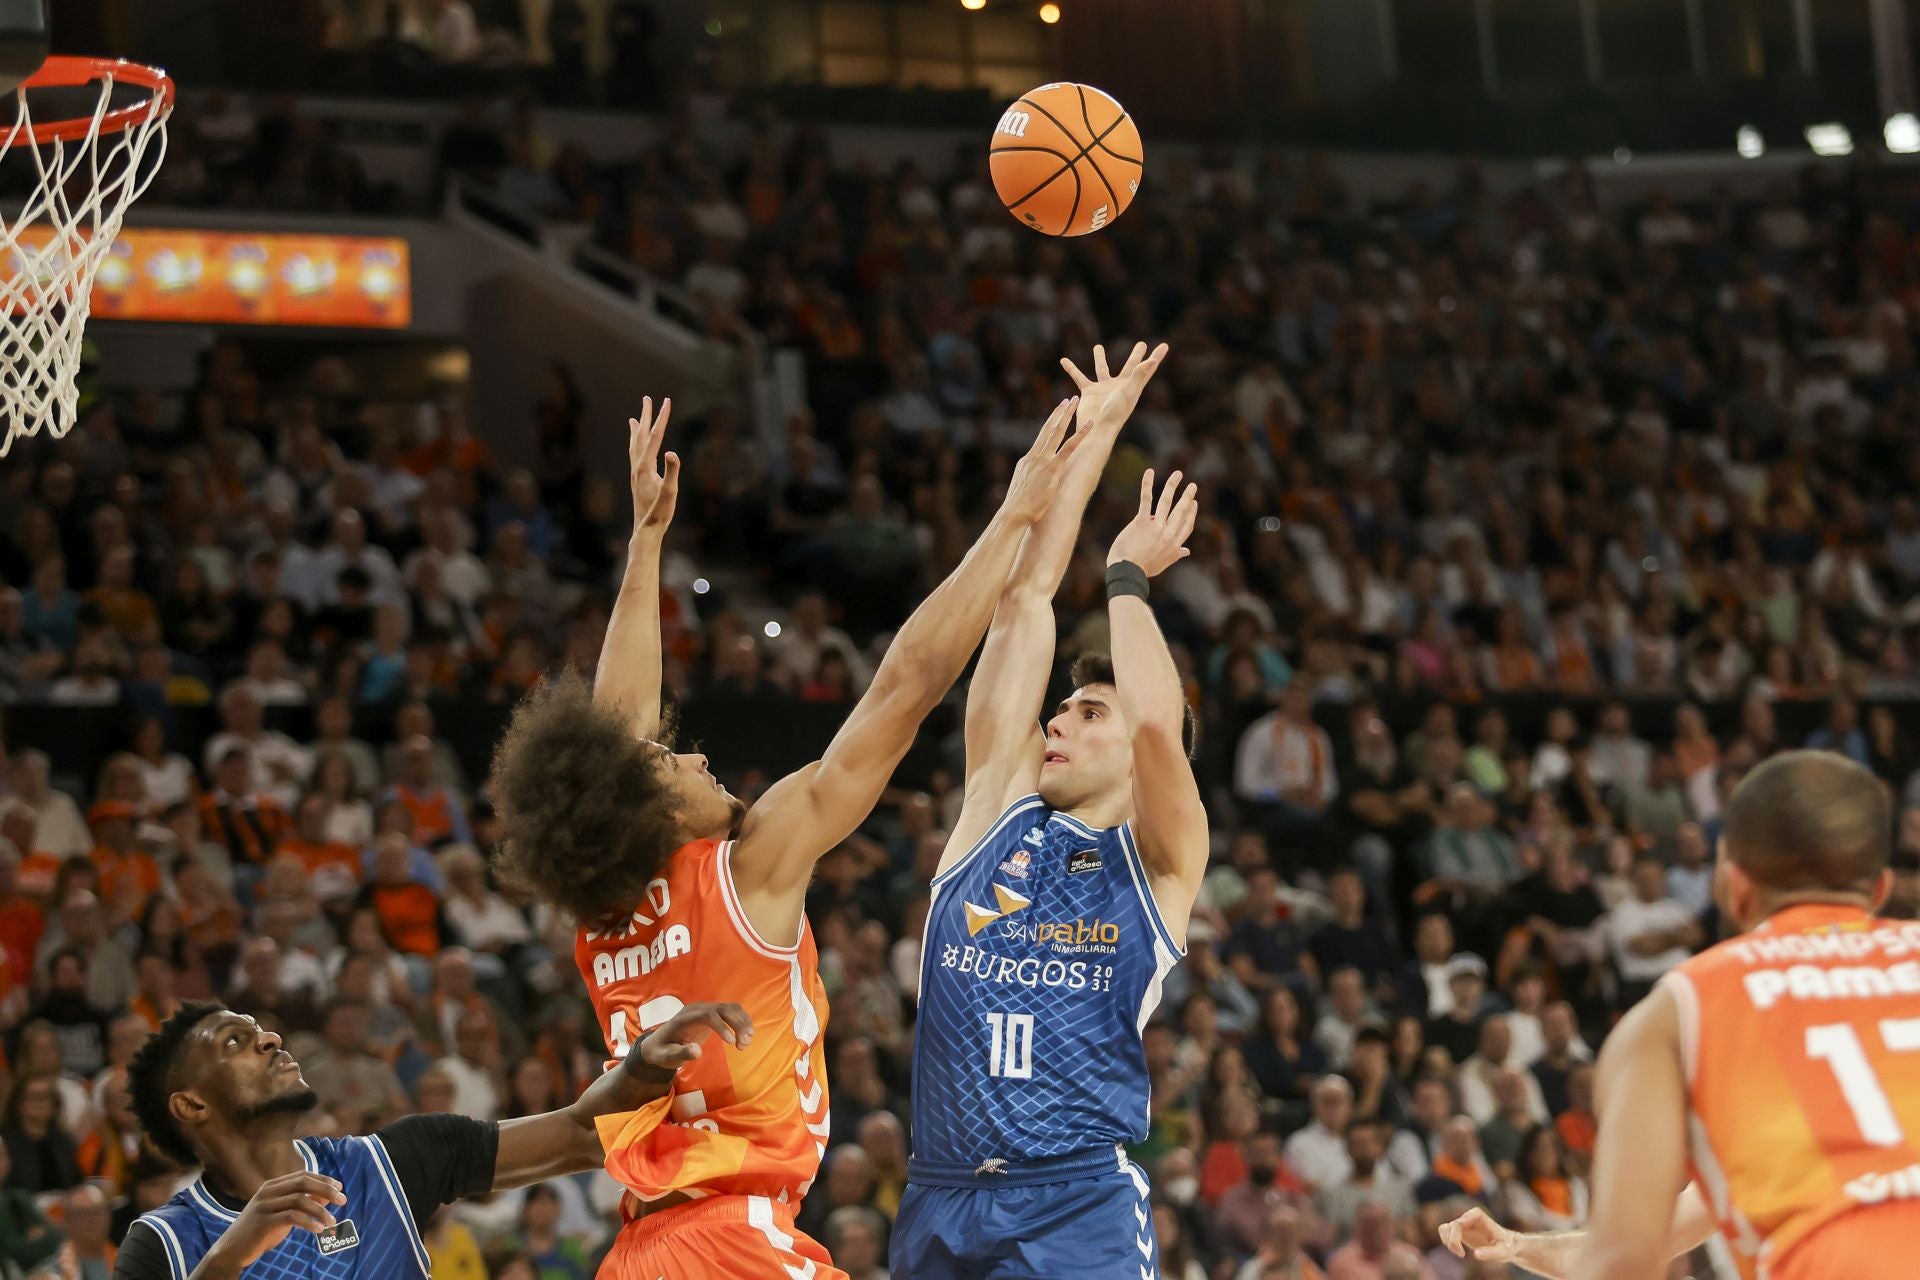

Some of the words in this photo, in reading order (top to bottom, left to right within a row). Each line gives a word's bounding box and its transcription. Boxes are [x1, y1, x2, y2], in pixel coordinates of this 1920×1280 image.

[958, 945, 1087, 989] BURGOS
[986, 1012, 1035, 1079] 10
[320, 1235, 337, 1244] liga
[323, 1236, 356, 1251] endesa
